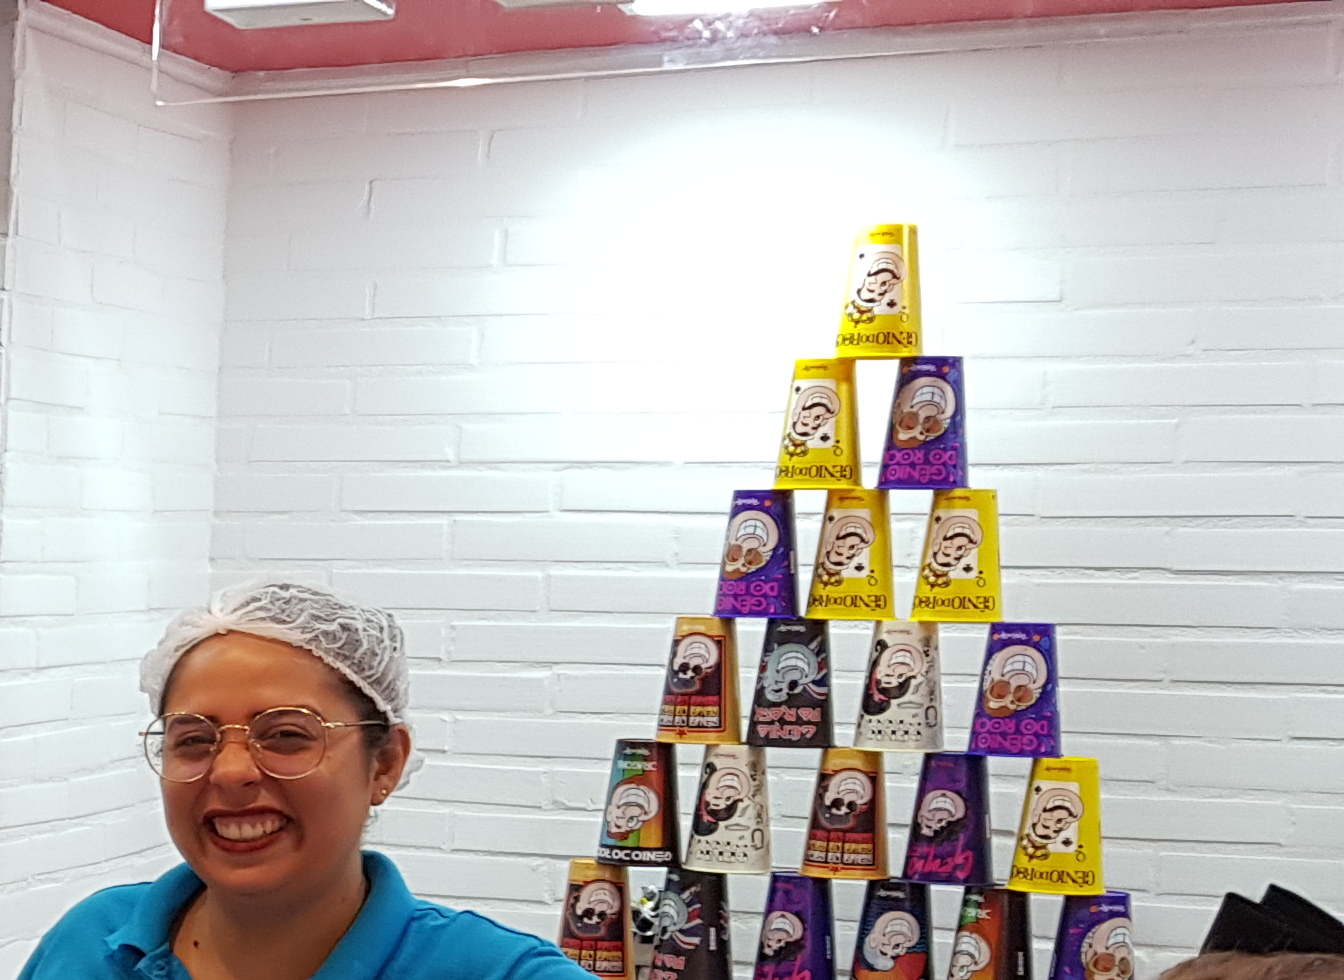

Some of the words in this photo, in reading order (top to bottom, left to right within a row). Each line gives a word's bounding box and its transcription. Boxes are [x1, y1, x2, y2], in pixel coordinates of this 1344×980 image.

[929, 449, 957, 464] DO
[887, 465, 946, 481] GÊNIO
[751, 580, 778, 595] DO
[1016, 718, 1048, 734] DO
[977, 735, 1039, 753] GÊNIO
